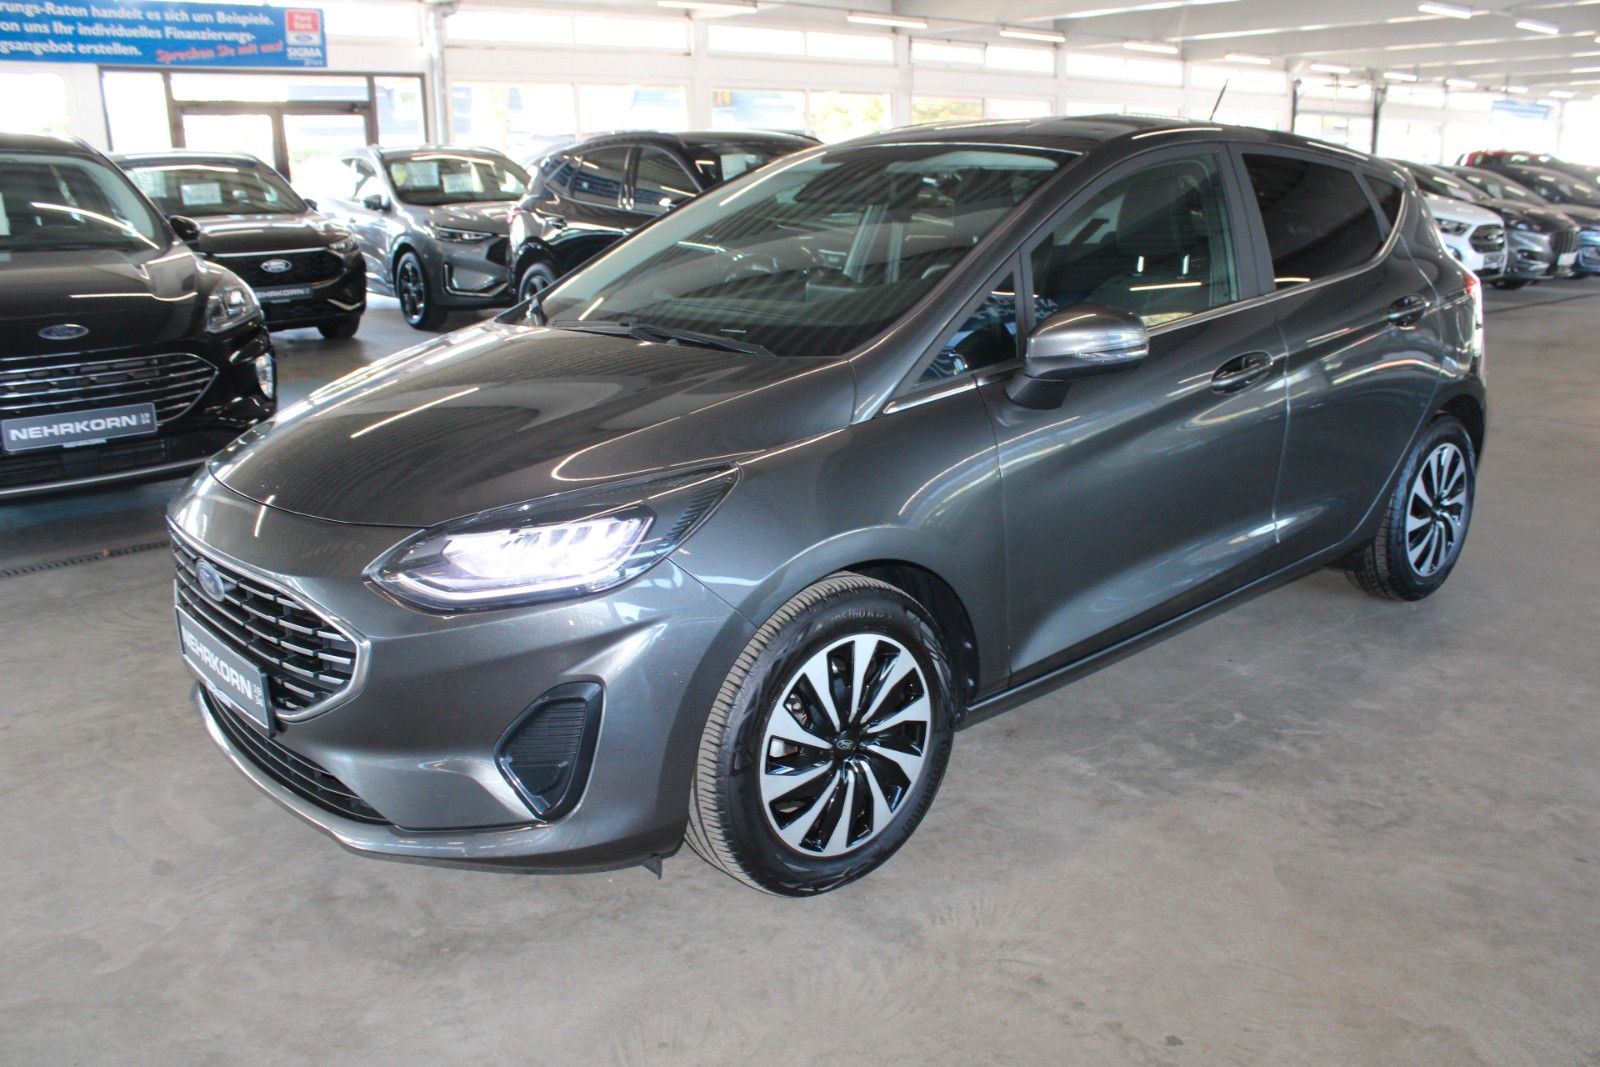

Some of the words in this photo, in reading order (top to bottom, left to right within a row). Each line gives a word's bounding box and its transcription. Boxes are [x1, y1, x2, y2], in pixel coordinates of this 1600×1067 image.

[90, 4, 144, 20] handelt
[145, 10, 162, 20] es
[163, 9, 189, 22] sich
[191, 13, 214, 23] um
[216, 10, 274, 27] Beispiele.
[23, 22, 50, 34] uns
[52, 20, 75, 35] Ihr
[77, 22, 162, 38] individuelles
[164, 25, 256, 45] Finanzierungs-
[77, 41, 143, 56] erstellen.
[9, 414, 138, 441] NEHRKORN
[181, 625, 253, 700] NEHRKORN
